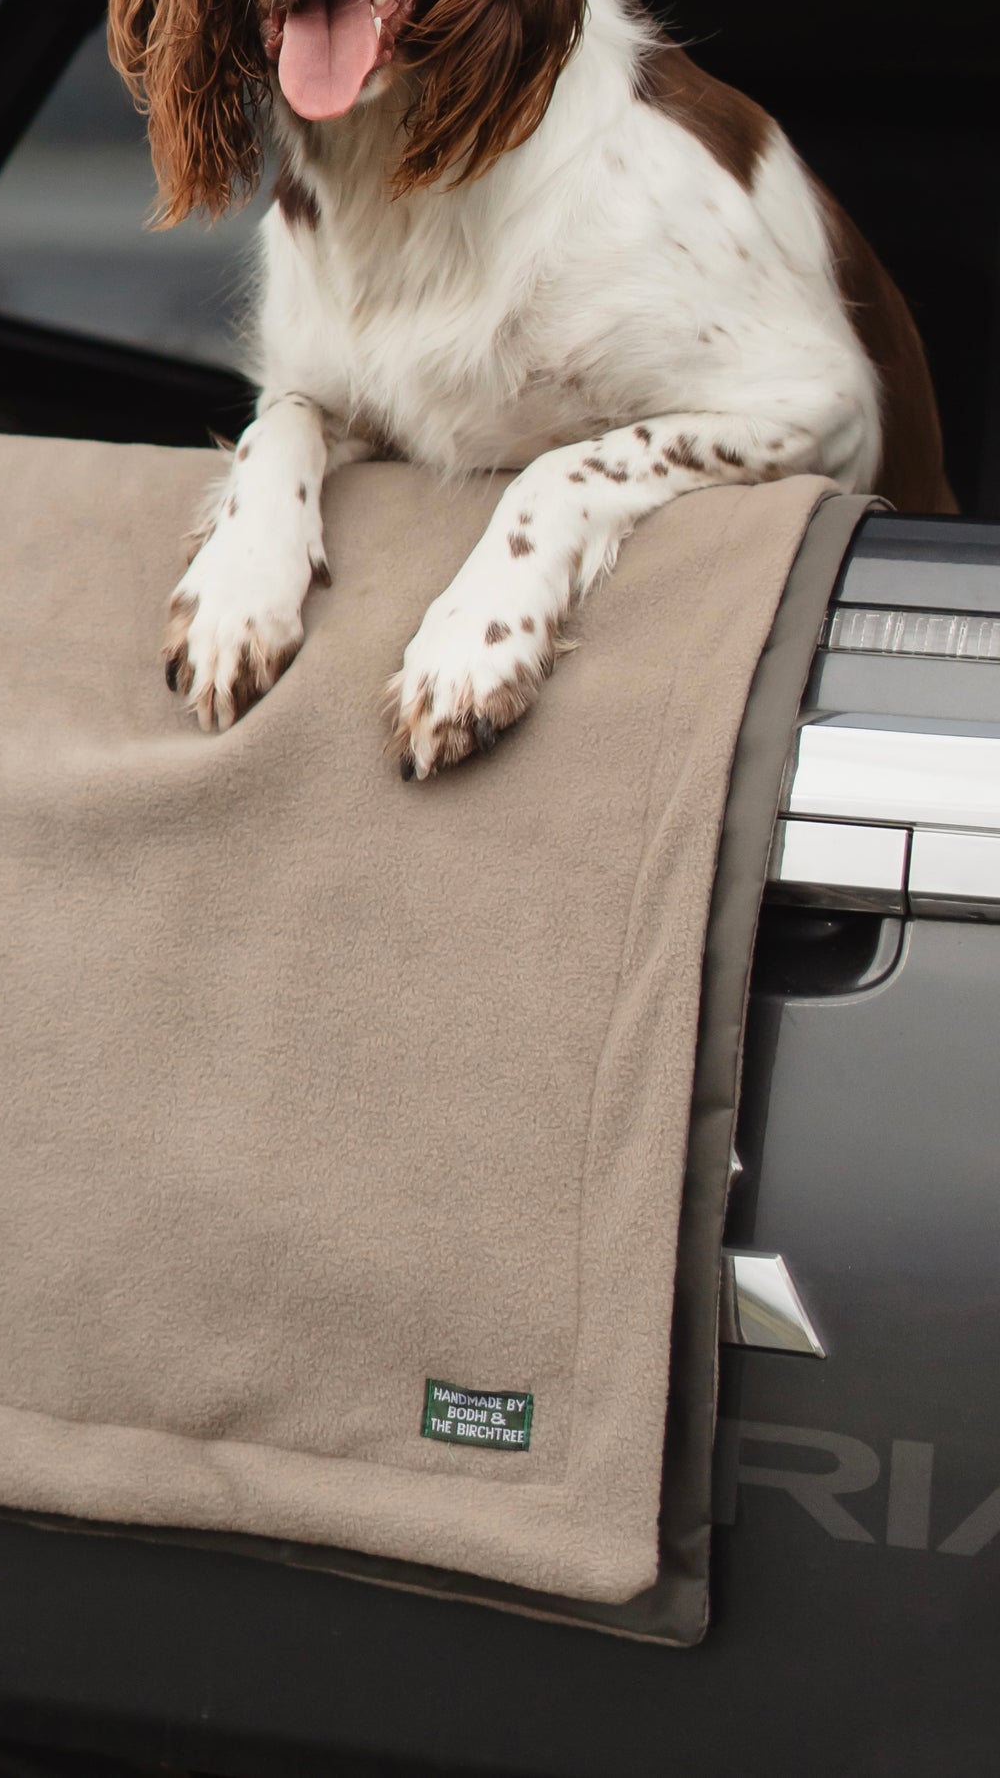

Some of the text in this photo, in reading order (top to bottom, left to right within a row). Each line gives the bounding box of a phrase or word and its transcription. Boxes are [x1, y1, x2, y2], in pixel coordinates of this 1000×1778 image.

[433, 1387, 526, 1412] HANDMADE BY
[447, 1405, 507, 1426] BODHI &
[431, 1418, 525, 1443] THE BIRCHTREE
